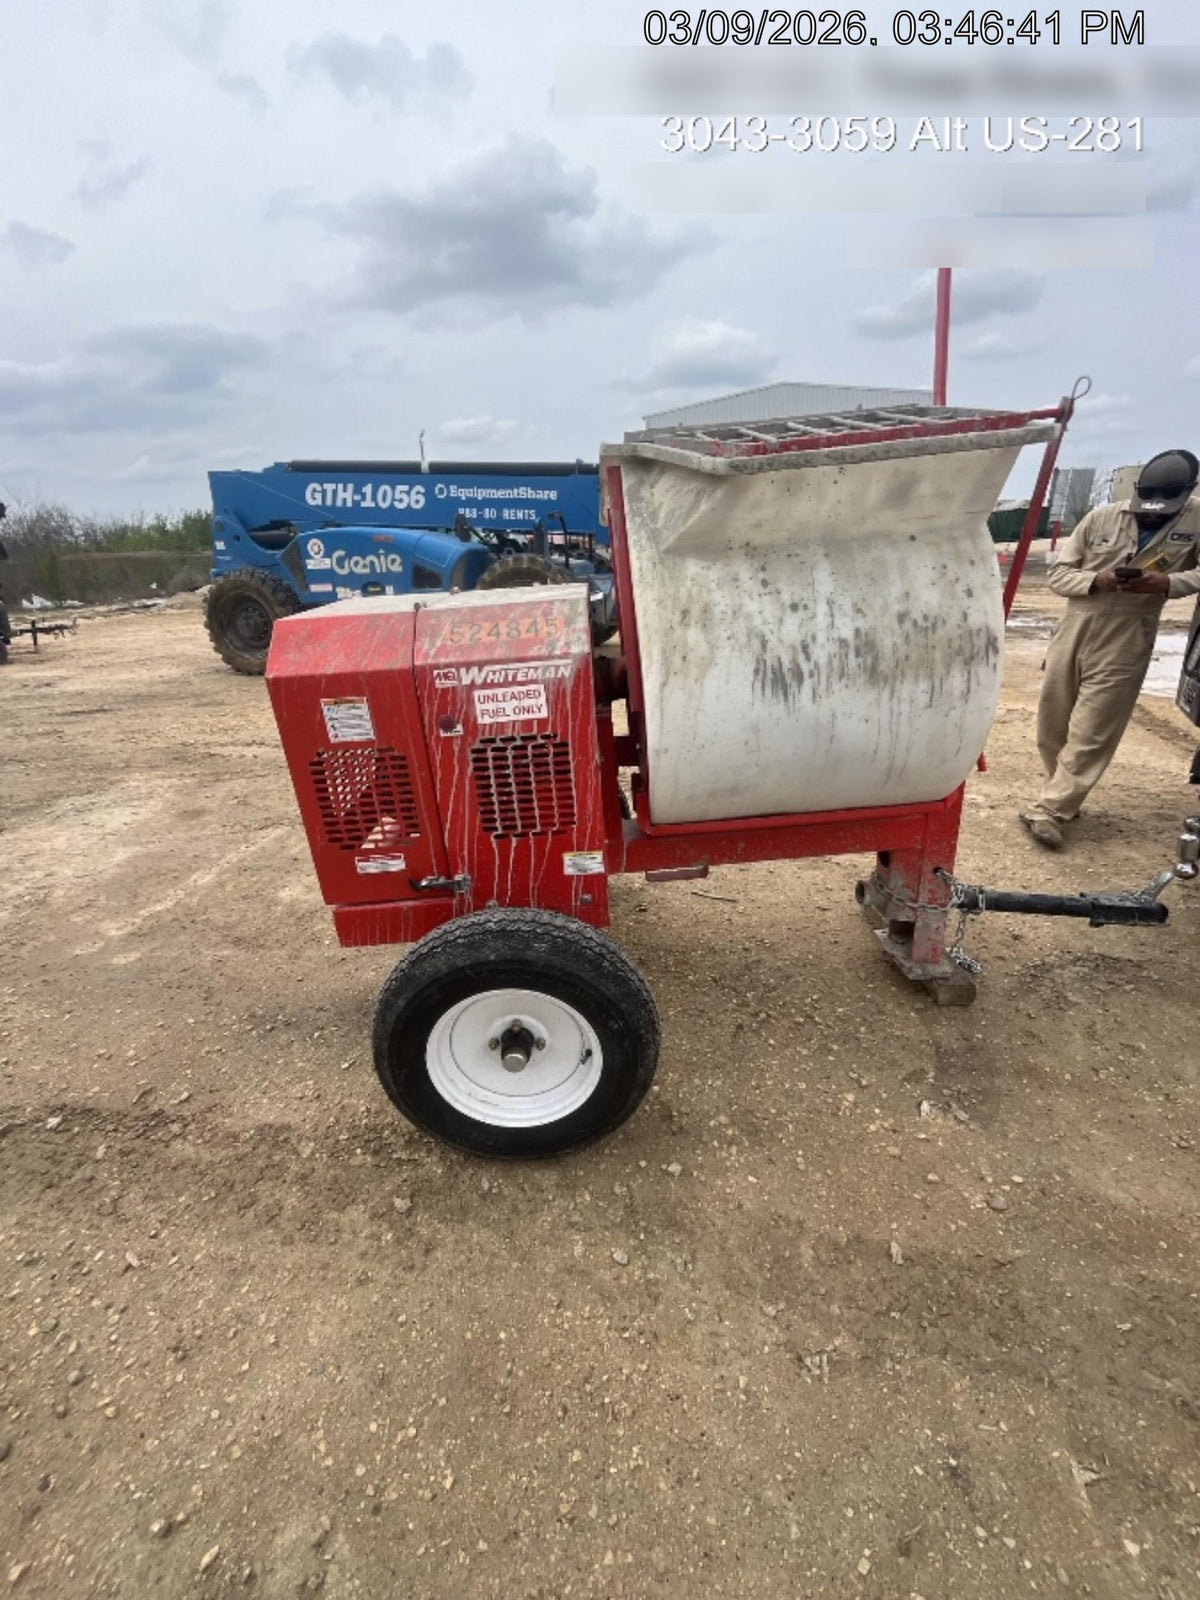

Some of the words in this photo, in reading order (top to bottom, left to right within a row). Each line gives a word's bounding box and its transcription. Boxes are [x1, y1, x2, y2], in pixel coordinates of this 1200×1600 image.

[305, 482, 426, 509] GTH-1056
[449, 484, 558, 500] EquipmentShare
[332, 548, 403, 575] Genie
[448, 616, 560, 644] 524845
[477, 689, 542, 705] UNLEADED
[481, 707, 511, 719] FUEL
[513, 703, 544, 716] ONLY
